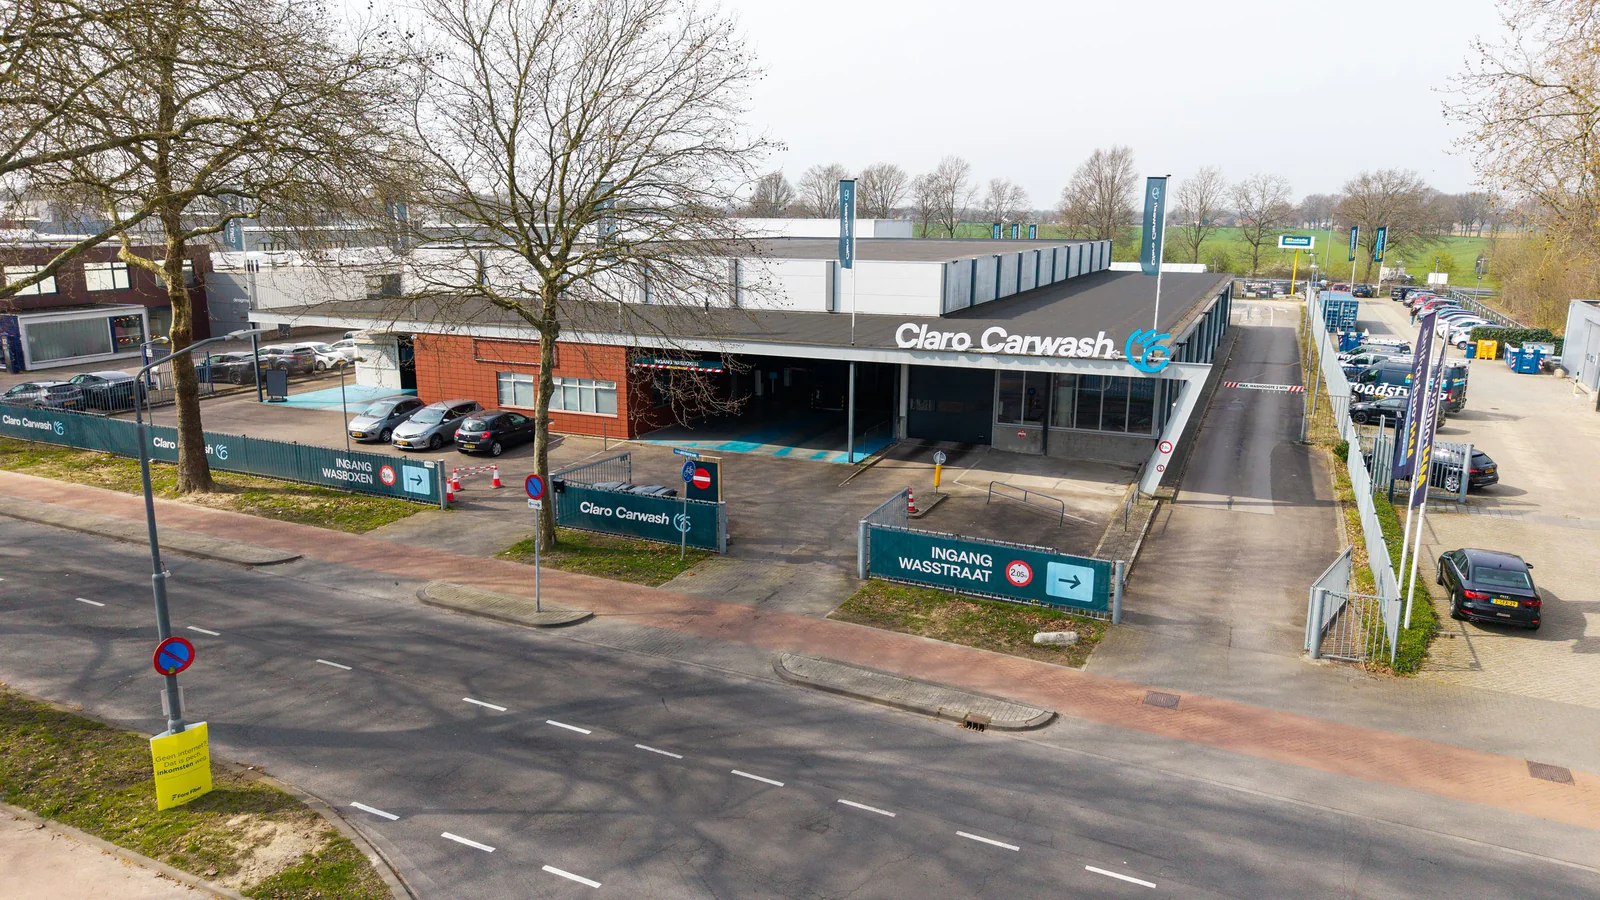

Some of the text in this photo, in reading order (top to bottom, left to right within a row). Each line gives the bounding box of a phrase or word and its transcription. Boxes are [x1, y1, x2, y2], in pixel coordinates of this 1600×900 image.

[895, 322, 1115, 358] Claro Carwash
[2, 414, 52, 431] Claro Carwash
[153, 437, 176, 449] Claro
[335, 457, 372, 472] INGANG
[322, 468, 373, 484] WASBOXEN
[580, 501, 669, 525] Claro Carwash
[931, 546, 993, 567] INGANG
[898, 557, 992, 583] WASSTRAAT
[155, 740, 207, 763] Geen internet?
[163, 760, 177, 768] Dat
